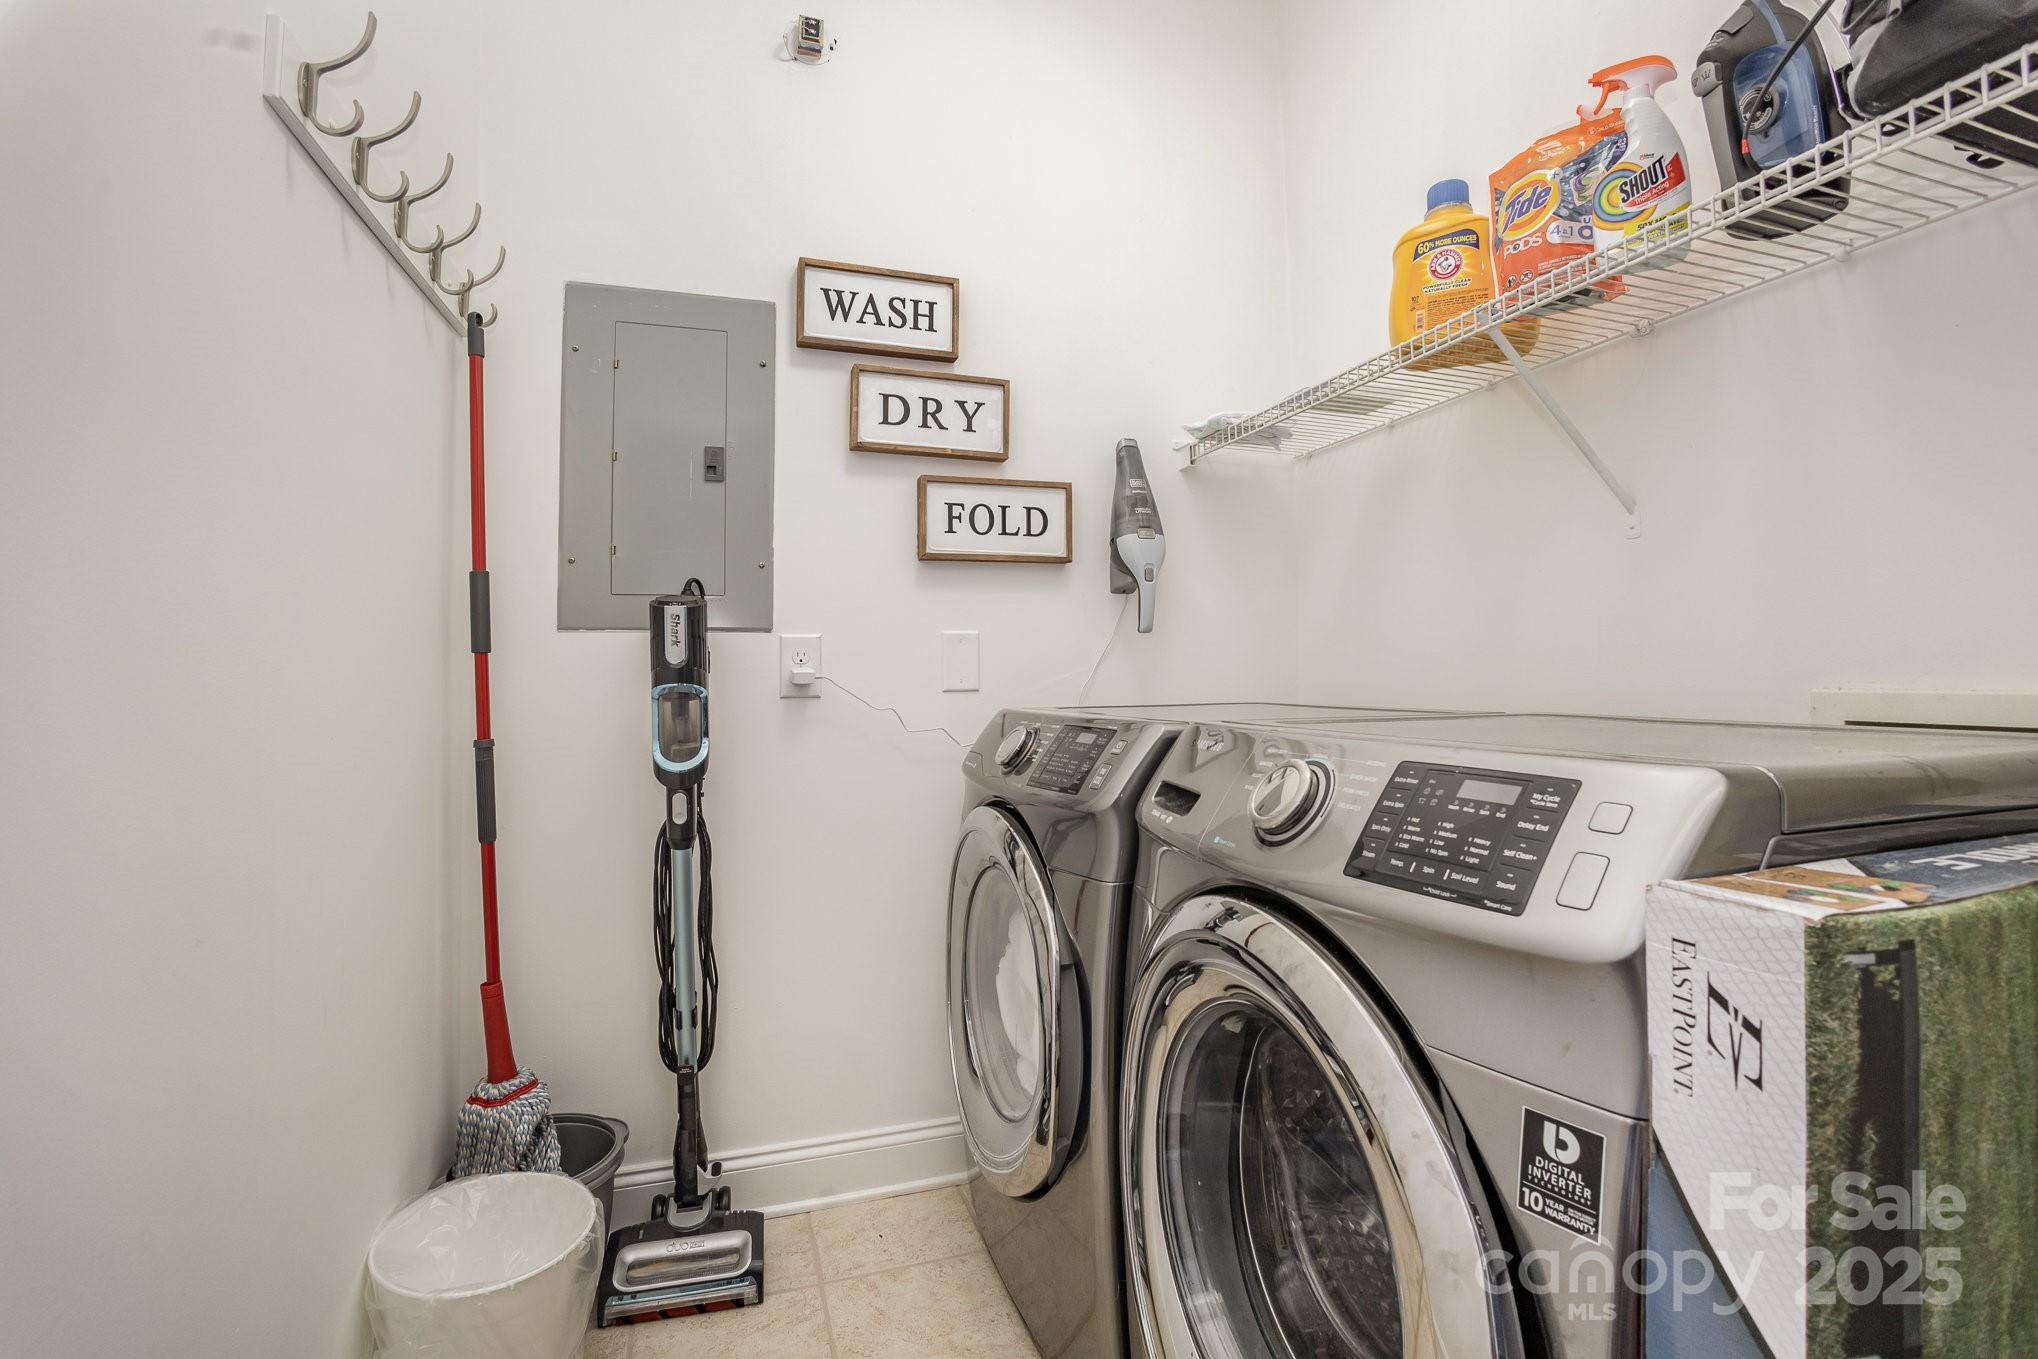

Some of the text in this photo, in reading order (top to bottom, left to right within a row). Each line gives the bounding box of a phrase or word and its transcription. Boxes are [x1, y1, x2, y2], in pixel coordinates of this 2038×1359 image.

[1619, 155, 1668, 204] SHOUT
[1651, 181, 1670, 197] Acting
[1502, 185, 1552, 235] Tide
[1417, 234, 1477, 254] 60% MORE OUNCES
[1503, 232, 1543, 259] PODS
[820, 287, 938, 333] WASH
[878, 392, 985, 433] DRY
[943, 502, 1049, 537] FOLD
[671, 614, 681, 648] Shark
[1532, 793, 1560, 803] My Cycle
[1517, 820, 1549, 832] Delay End
[1465, 856, 1480, 864] Light
[1503, 849, 1516, 858] Self
[1450, 872, 1462, 880] Soil
[1462, 874, 1480, 884] Level
[1495, 880, 1516, 891] Sound
[1672, 937, 1696, 1098] EASTPOINT
[1528, 1163, 1592, 1200] INVERTER
[1535, 1156, 1585, 1186] DIGITAL
[1522, 1187, 1565, 1212] 10 YEAR
[1545, 1205, 1596, 1235] WARRANTY
